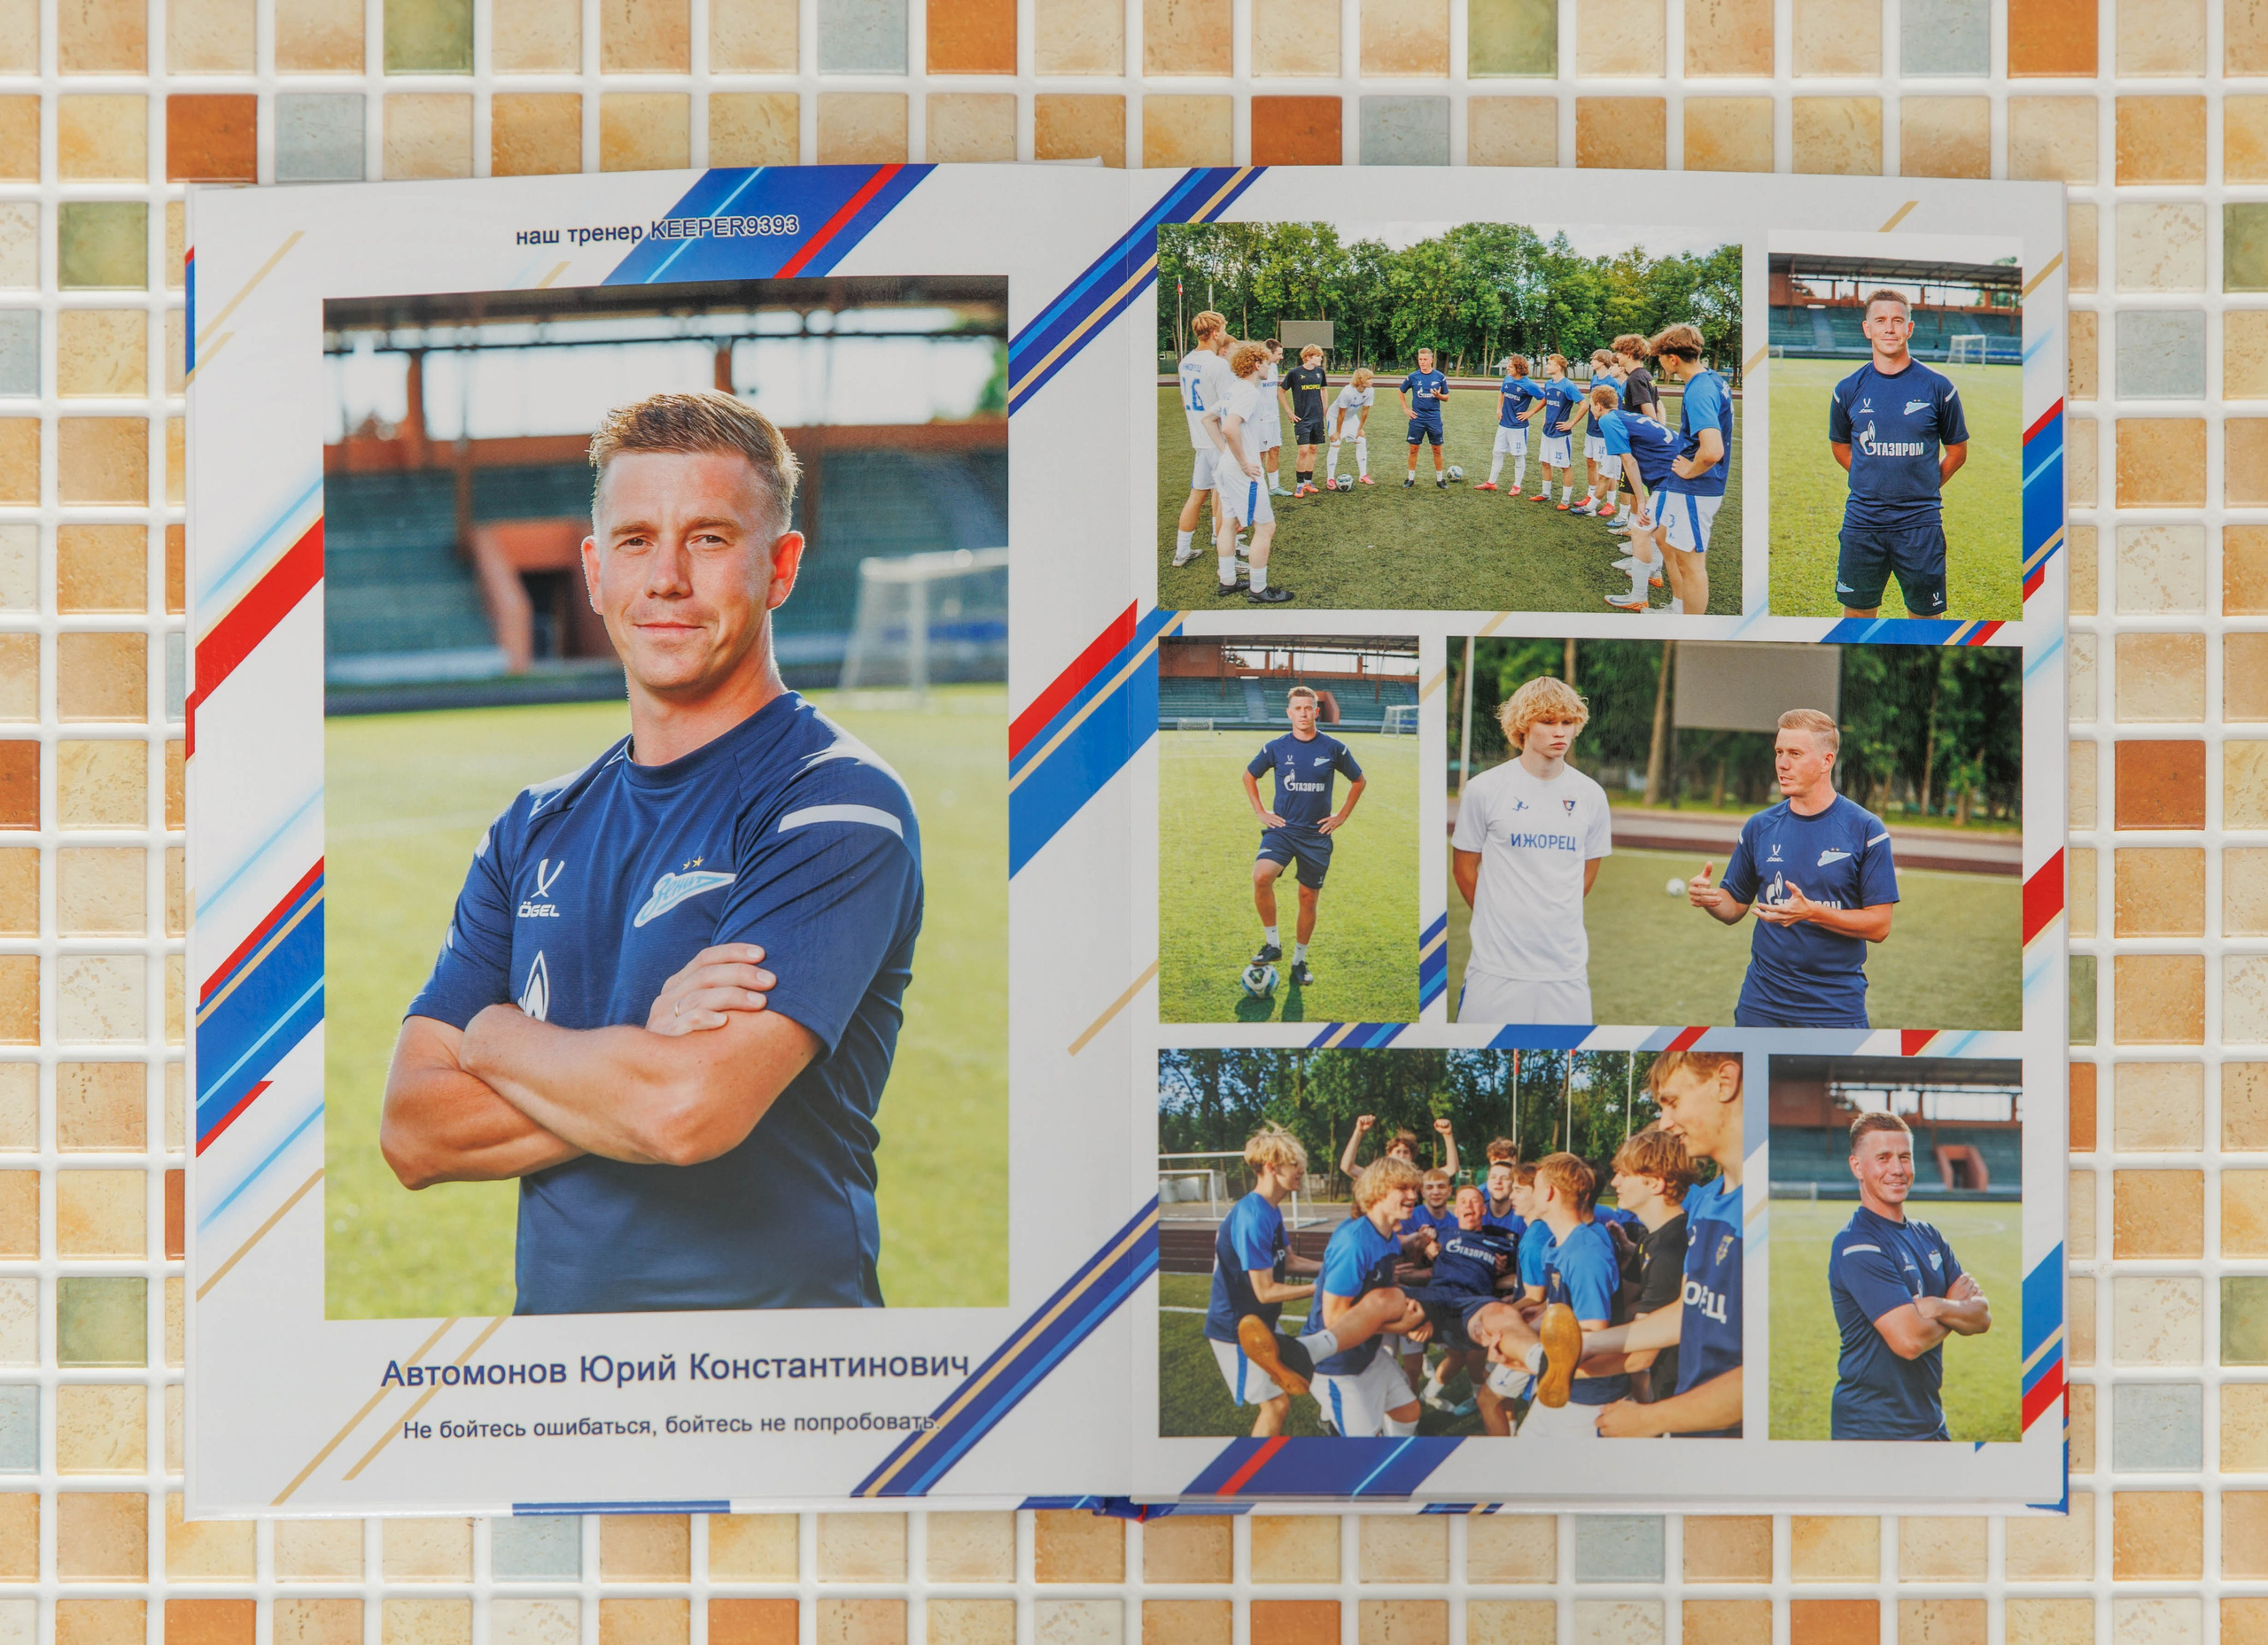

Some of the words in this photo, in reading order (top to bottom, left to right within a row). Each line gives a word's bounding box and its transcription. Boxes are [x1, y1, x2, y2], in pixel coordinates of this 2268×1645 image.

[516, 228, 560, 244] наш
[567, 222, 643, 246] тренер
[650, 215, 799, 240] KEEPER9393
[1876, 441, 1924, 456] ГАЗПРОМ
[1510, 833, 1576, 852] ИЖОРЕЦ
[381, 1360, 567, 1387] Автомонов
[579, 1354, 677, 1389] Юрий
[689, 1353, 969, 1380] Константинович
[403, 1421, 432, 1439] Не
[439, 1419, 526, 1439] бойтесь
[532, 1417, 657, 1437] ошибаться,
[665, 1416, 753, 1433] бойтесь
[760, 1417, 786, 1432] не
[794, 1412, 942, 1436] попробовать.
